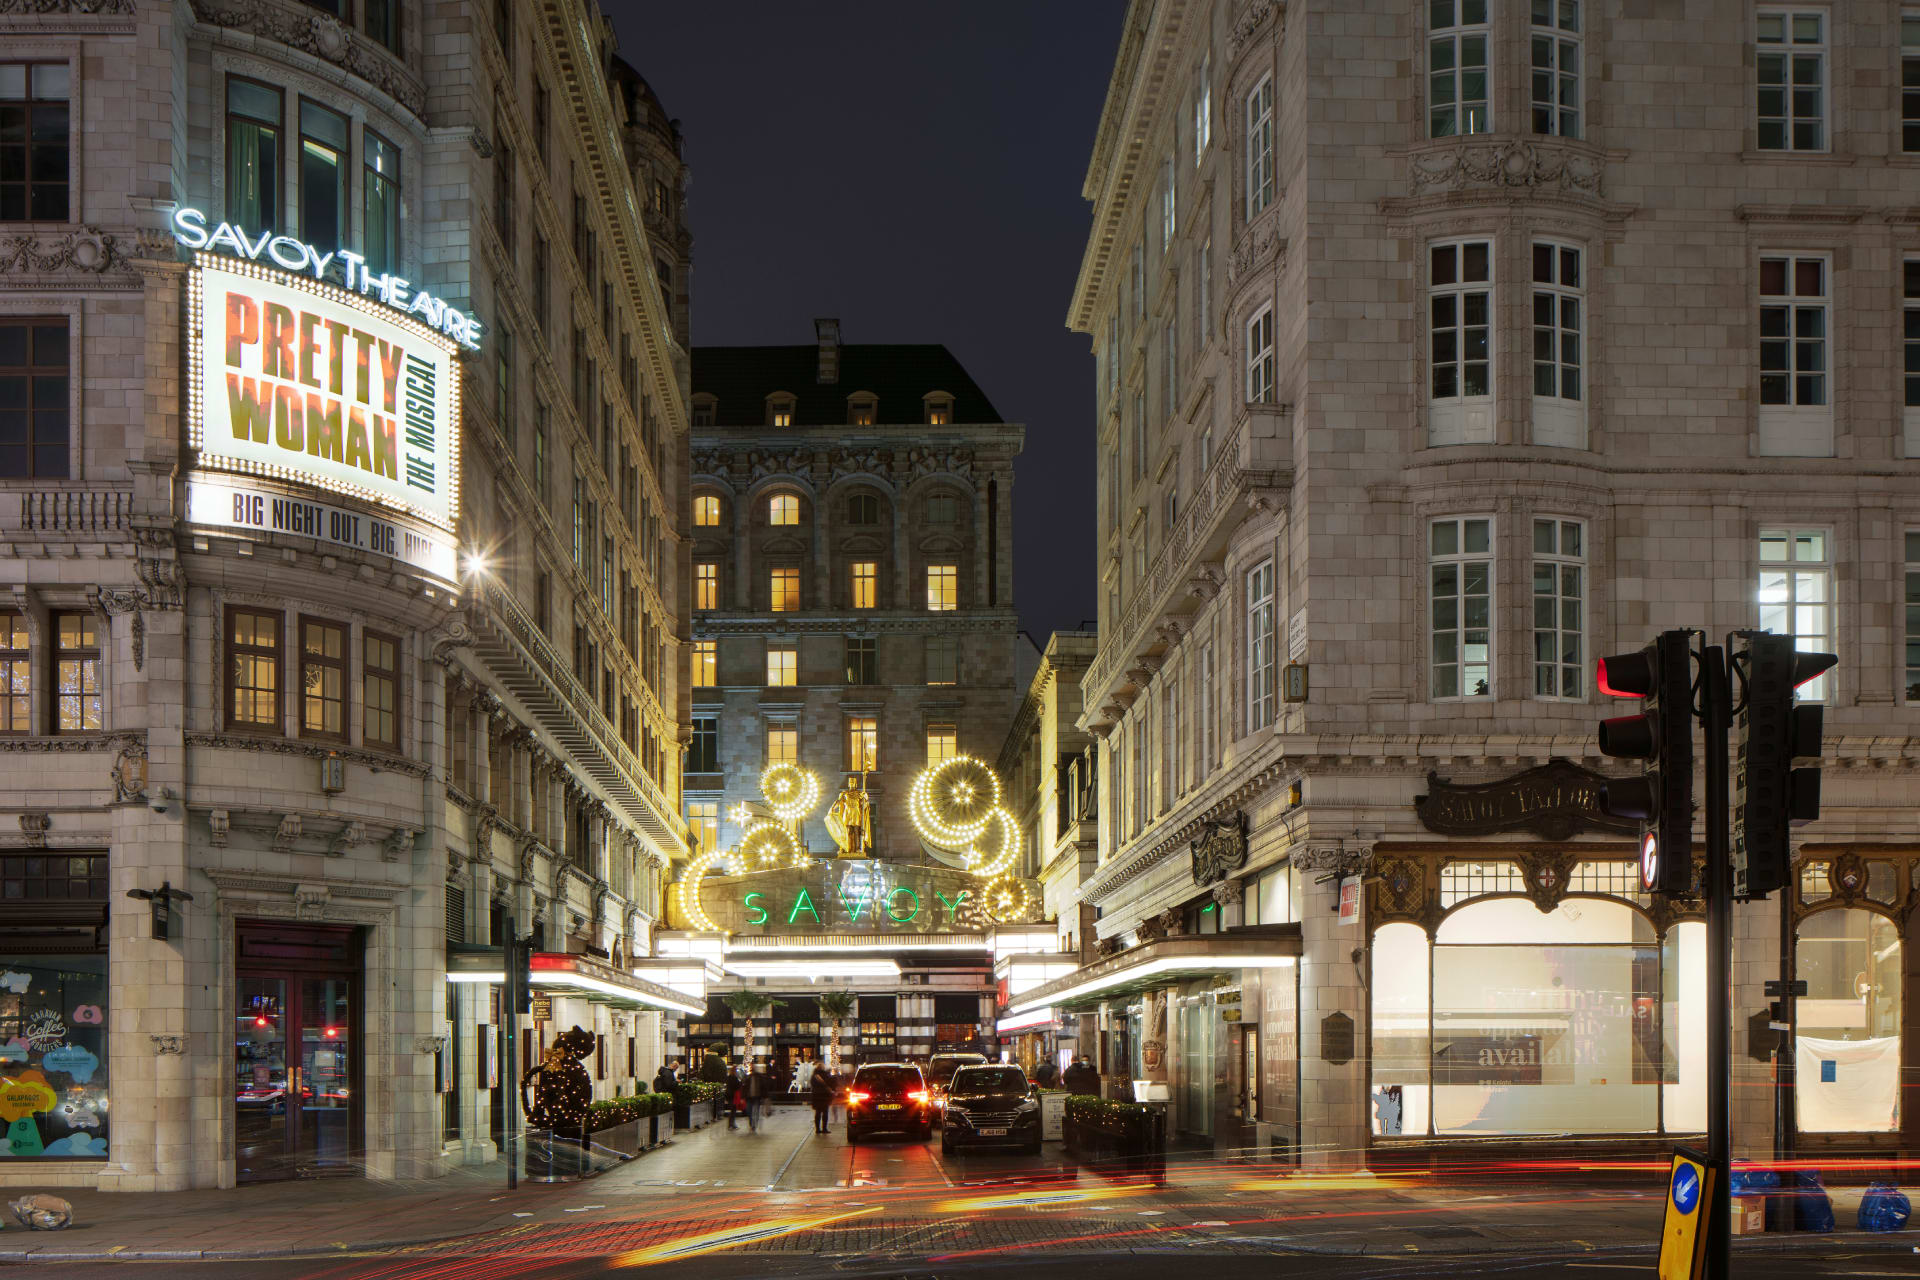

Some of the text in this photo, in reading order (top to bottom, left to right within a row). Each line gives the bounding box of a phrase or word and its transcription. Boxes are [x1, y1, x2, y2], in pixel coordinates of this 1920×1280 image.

[172, 208, 482, 351] SAVOY THEATRE
[225, 291, 404, 413] PRETTY
[225, 373, 398, 481] WOMAN
[407, 353, 436, 494] THE MUSICAL
[233, 493, 264, 526] BIG
[272, 499, 323, 537] NIGHT
[330, 510, 364, 546] OUT.
[370, 521, 399, 557] BIG.
[744, 884, 968, 925] SAVOY
[26, 1019, 66, 1041] Coffee
[30, 1008, 62, 1022] CARAVAN
[31, 1039, 63, 1052] ROASTERS
[1479, 1040, 1608, 1066] available
